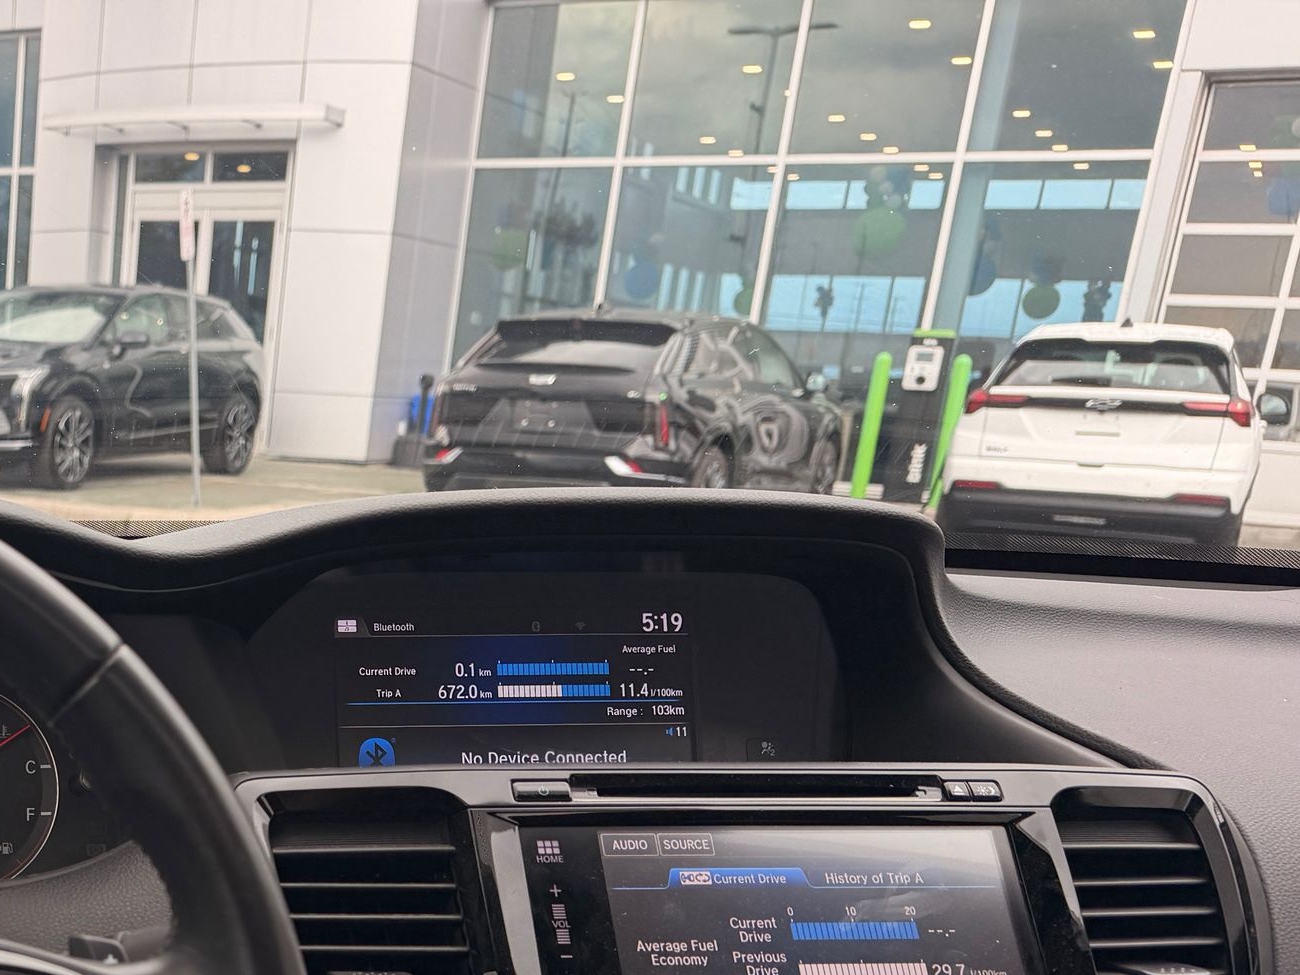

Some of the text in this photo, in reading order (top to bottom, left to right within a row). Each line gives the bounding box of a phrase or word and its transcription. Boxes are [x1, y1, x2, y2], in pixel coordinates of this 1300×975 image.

[373, 613, 683, 632] Bluetooth 5:19
[622, 644, 676, 655] Average Fuel
[358, 667, 393, 676] Current
[395, 667, 417, 676] Drive
[455, 662, 475, 677] 0.1
[479, 668, 492, 677] km
[376, 689, 393, 699] Trip
[395, 689, 402, 698] A
[438, 684, 478, 699] 672.0
[480, 690, 493, 699] km
[619, 683, 649, 698] 11.4
[651, 705, 685, 716] 103km
[676, 726, 688, 737] 11
[462, 750, 627, 764] No Device Connected
[25, 760, 36, 775] C
[26, 808, 35, 822] F
[612, 839, 648, 850] AUDIO
[663, 839, 710, 850] SOURCE
[536, 855, 564, 864] HOME
[713, 874, 787, 884] Current Drive
[824, 872, 924, 887] History of Trip A
[786, 906, 916, 916] 0 10 20
[552, 920, 571, 928] VOL
[729, 917, 778, 929] Current
[739, 931, 772, 942] Drive
[636, 940, 718, 953] Average Fuel
[651, 954, 708, 967] Economy
[732, 951, 787, 964] Previous
